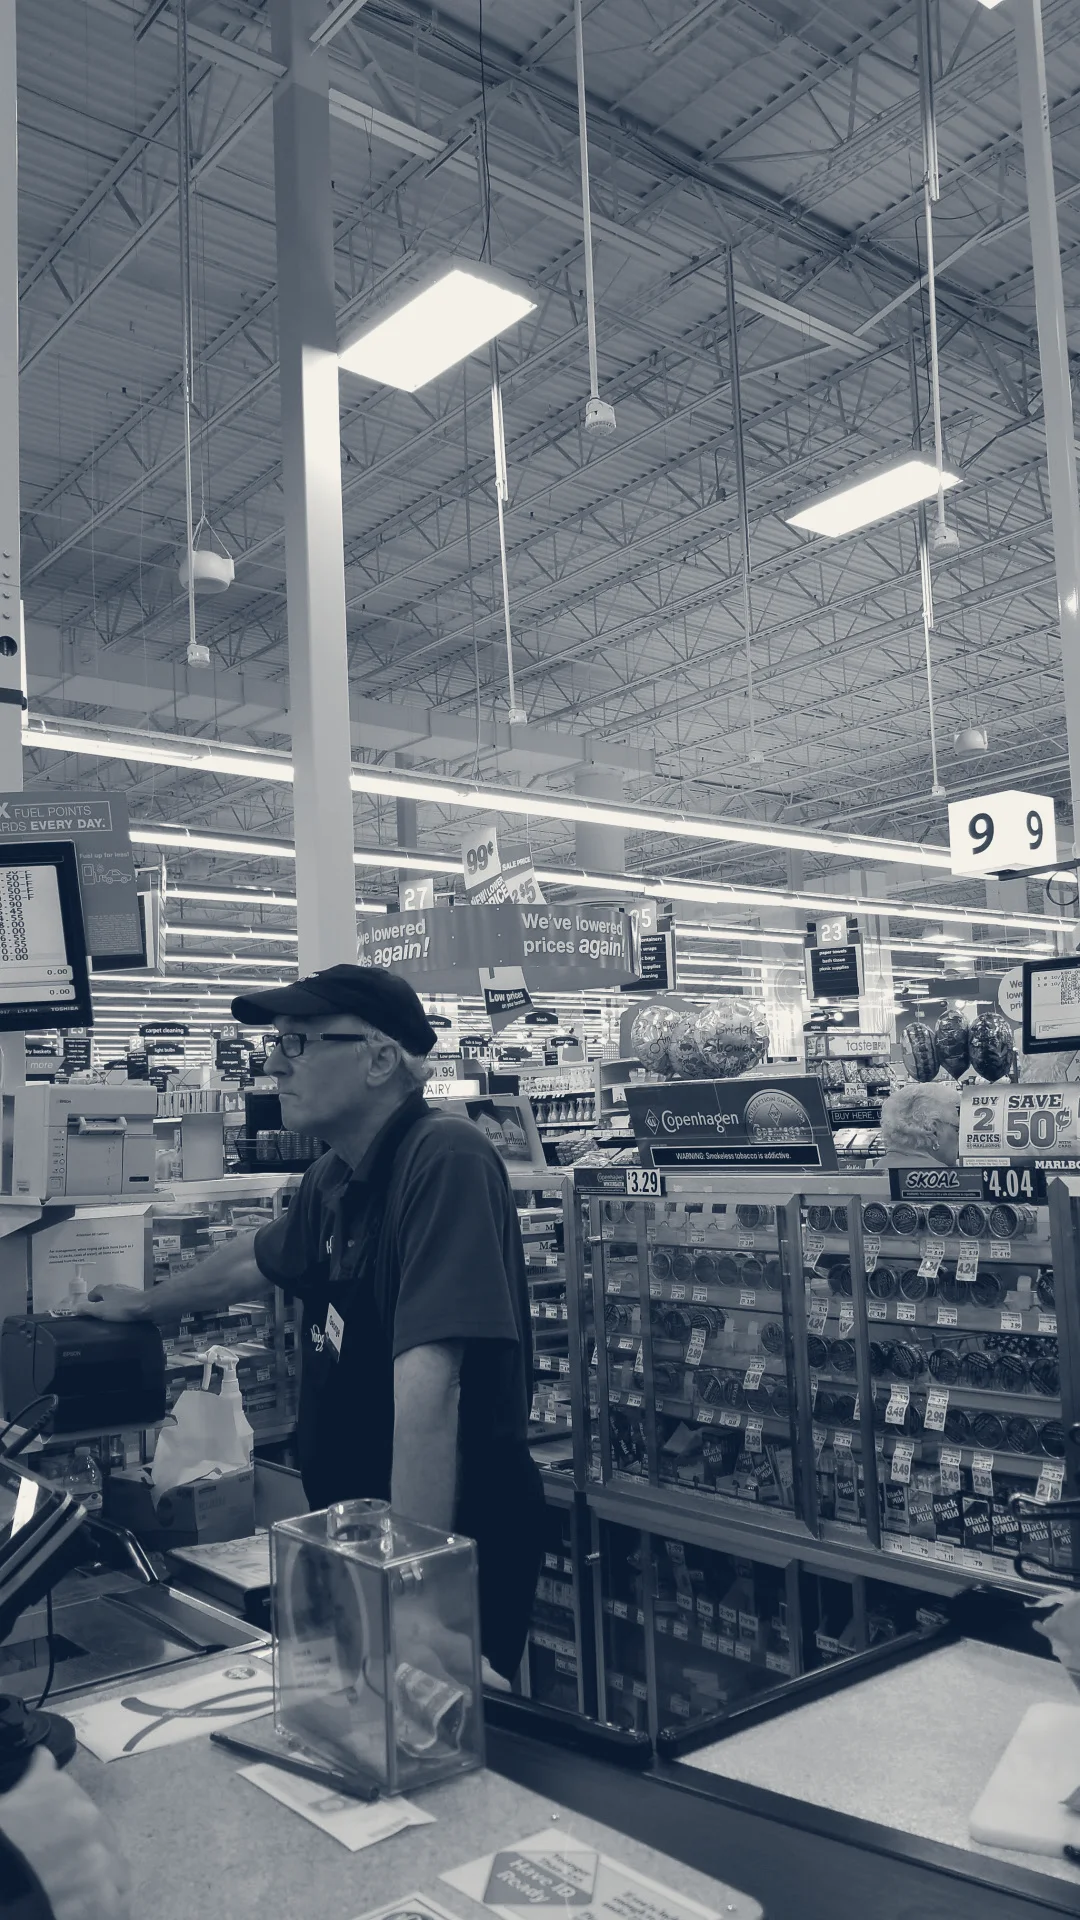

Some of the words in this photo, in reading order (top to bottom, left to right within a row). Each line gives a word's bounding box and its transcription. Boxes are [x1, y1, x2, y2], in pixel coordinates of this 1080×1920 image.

[14, 807, 44, 818] FUEL
[48, 805, 92, 816] POINTS
[30, 819, 73, 831] EVERY
[1026, 810, 1043, 850] 9
[968, 812, 994, 855] 9
[94, 853, 103, 861] up
[466, 840, 494, 875] 99¢
[502, 860, 516, 872] SALE
[516, 856, 531, 866] PRICE
[404, 886, 428, 910] 27
[371, 918, 426, 942] lowered
[521, 912, 571, 931] We've
[575, 916, 623, 936] lowered
[821, 923, 842, 941] 23
[373, 936, 431, 968] again!
[523, 938, 575, 956] prices
[578, 936, 626, 958] again!
[47, 968, 68, 976] 0.00
[49, 988, 70, 996] 0.00
[488, 990, 505, 1003] Low
[506, 991, 524, 1003] prices
[162, 1027, 185, 1035] cleaning
[223, 1026, 235, 1037] 23
[131, 1039, 142, 1049] 22
[845, 1039, 873, 1051] taste
[30, 1061, 54, 1069] more
[971, 1096, 999, 1106] BUY
[1008, 1094, 1063, 1109] SAVE
[661, 1109, 740, 1134] Copenhagen
[834, 1112, 850, 1120] BUY
[852, 1111, 875, 1120] HERE,
[972, 1107, 995, 1132] 2
[1006, 1106, 1072, 1149] 50¢
[966, 1134, 1001, 1143] PACKS
[675, 1152, 706, 1160] WARNING:
[706, 1151, 735, 1160] Smokeless
[734, 1152, 758, 1160] tobacco
[758, 1151, 764, 1159] is
[764, 1150, 792, 1159] addictive.
[905, 1170, 960, 1189] SKOAL
[983, 1169, 1034, 1198] $4.04
[958, 1261, 976, 1274] 4.24
[886, 1405, 905, 1419] 3.49
[926, 1409, 945, 1424] 2.99
[745, 1434, 761, 1446] 2.99
[892, 1462, 910, 1476] 3.49
[941, 1469, 959, 1483] 3.49
[974, 1474, 991, 1488] 2.99
[837, 1480, 854, 1490] Black
[887, 1489, 903, 1500] Black
[909, 1502, 932, 1515] Black
[933, 1499, 958, 1513] Black
[916, 1511, 934, 1523] Mild
[941, 1508, 959, 1521] Mild
[964, 1513, 989, 1527] Black
[972, 1523, 991, 1536] Mild
[1000, 1521, 1019, 1533] Mild
[1021, 1520, 1047, 1535] Black
[1029, 1529, 1050, 1542] Mild
[509, 1859, 553, 1887] Have
[551, 1882, 576, 1898] ID
[496, 1870, 551, 1903] Ready
